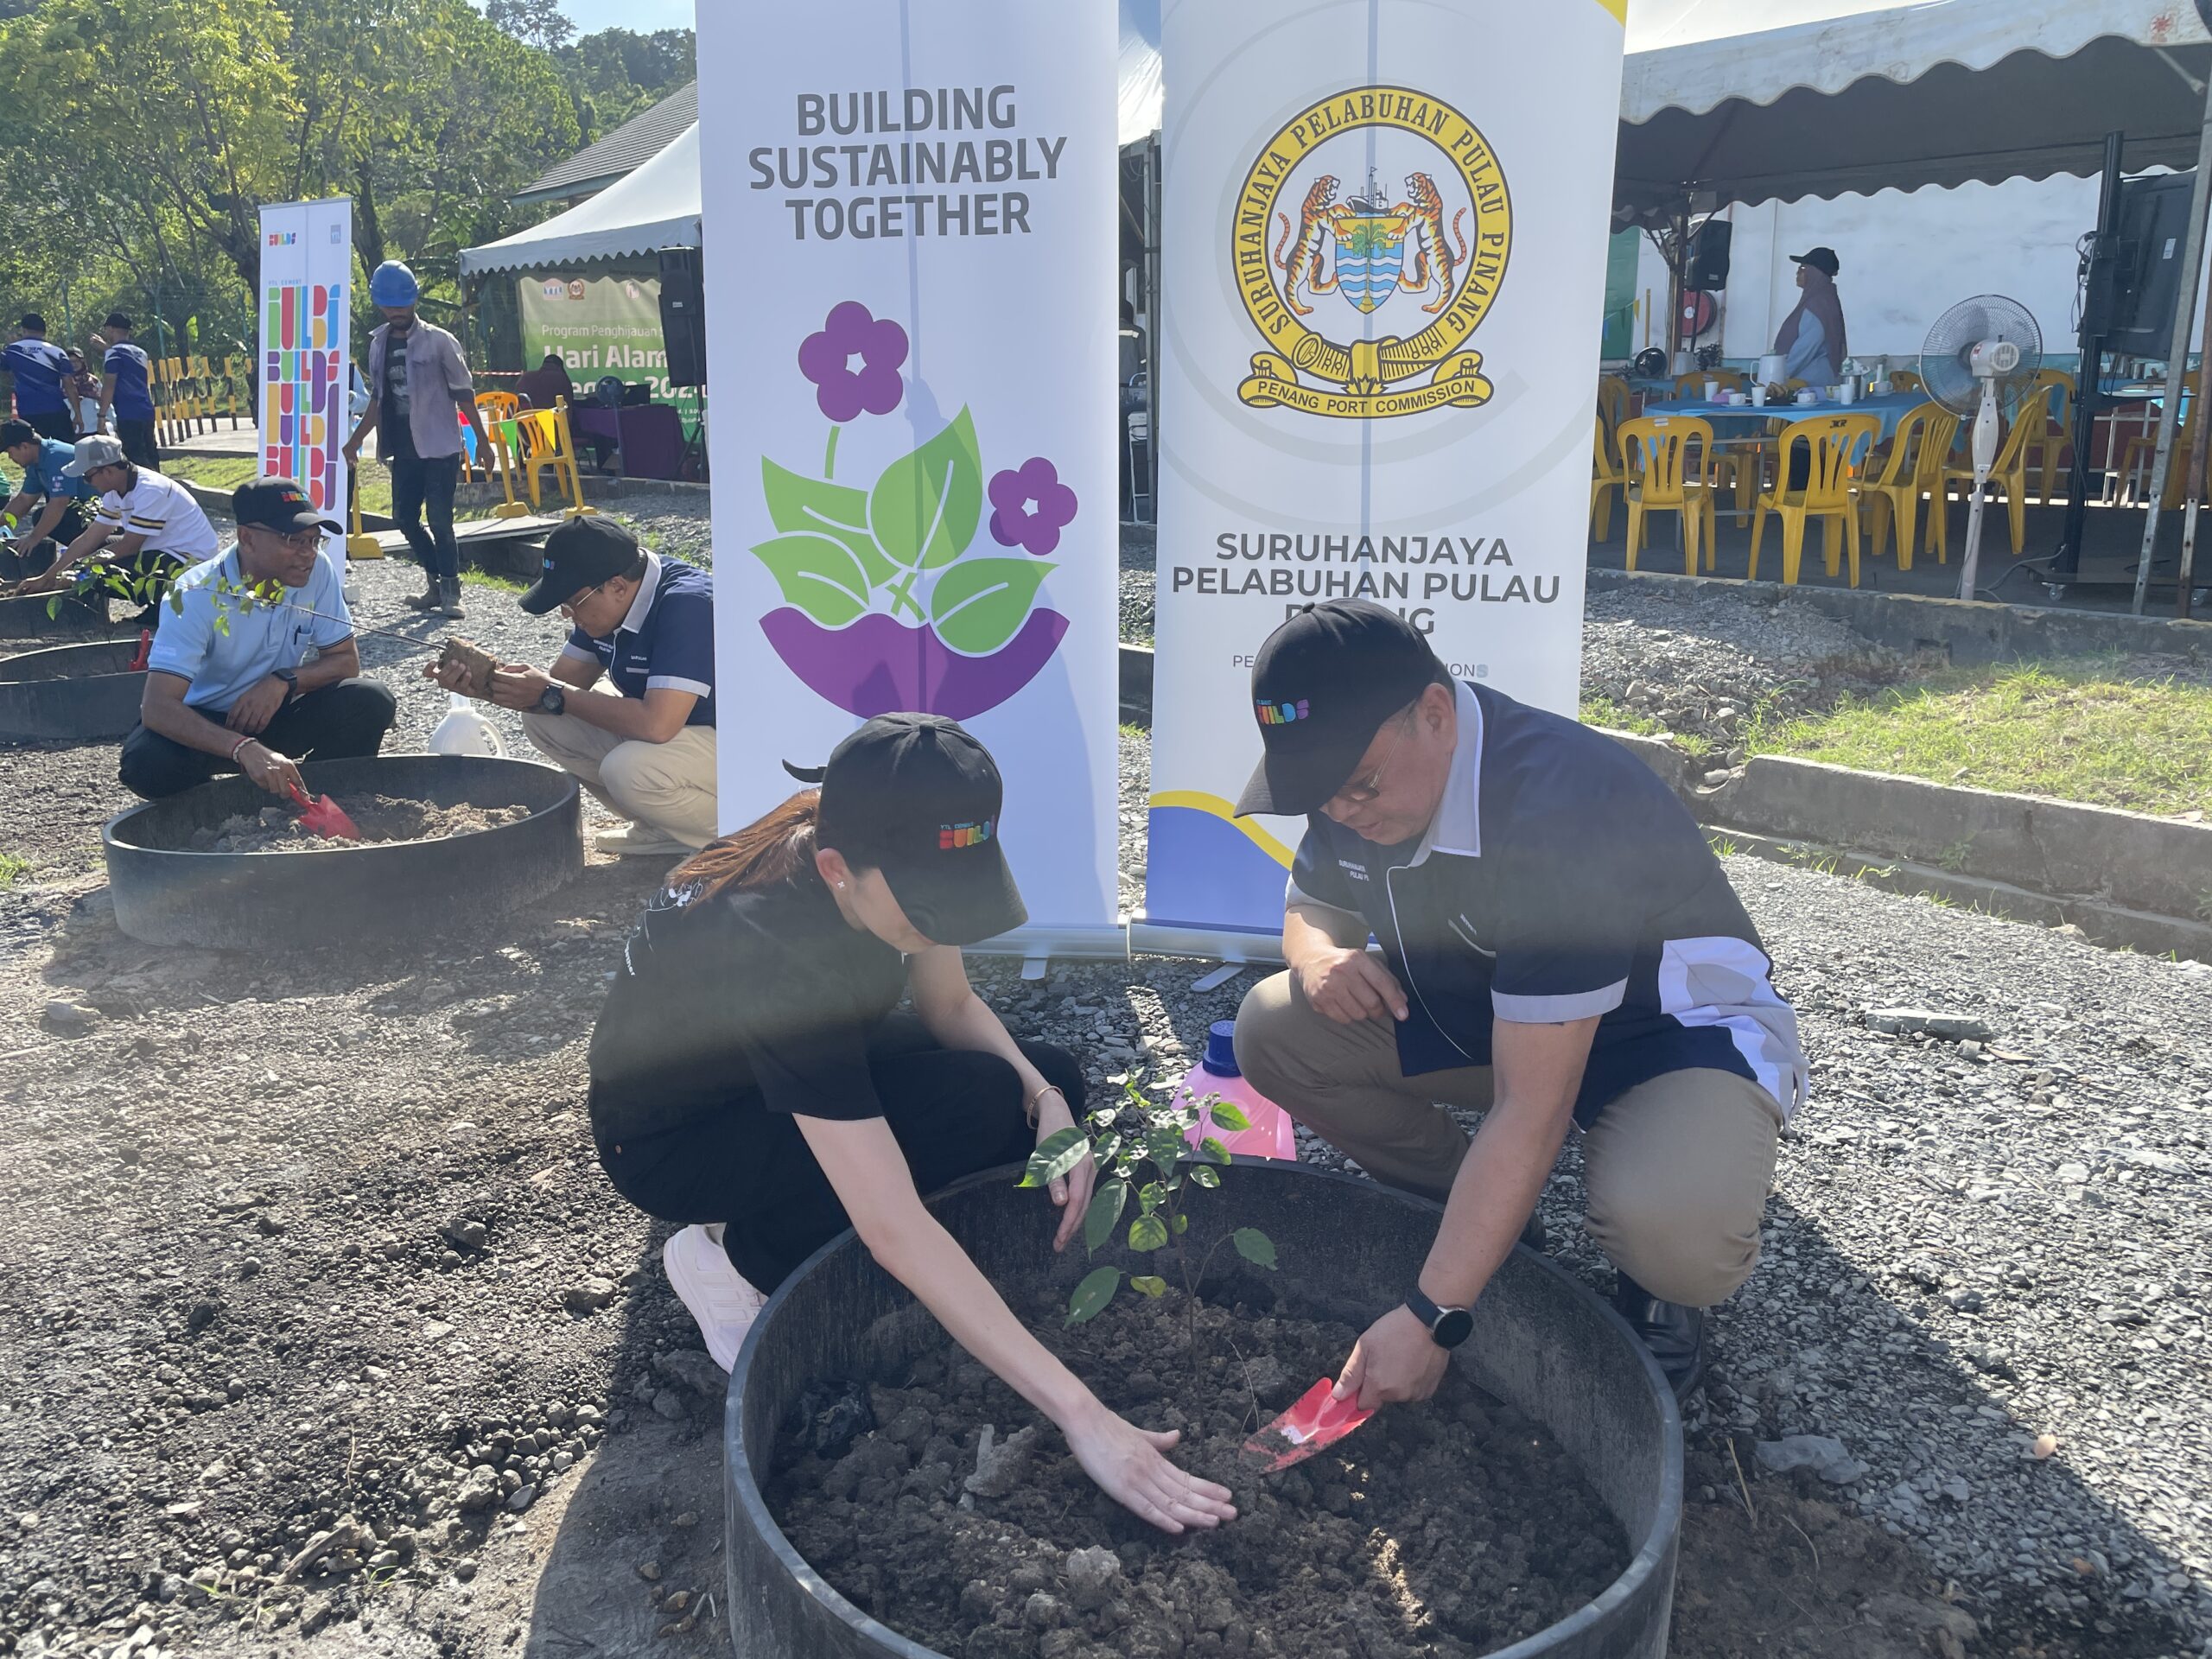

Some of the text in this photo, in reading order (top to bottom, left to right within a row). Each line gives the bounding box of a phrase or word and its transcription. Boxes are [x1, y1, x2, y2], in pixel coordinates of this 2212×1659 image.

[797, 85, 1015, 136] BUILDING
[748, 136, 1067, 190] SUSTAINABLY
[785, 191, 1031, 240] TOGETHER
[1240, 93, 1505, 335] SURUHANJAYA PELABUHAN PULAU PINANG
[542, 325, 589, 339] Program
[591, 325, 657, 339] Penghijauan
[1257, 379, 1475, 415] PENANG PORT COMMISSION
[1216, 531, 1513, 567] SURUHANJAYA
[1173, 566, 1560, 604] PELABUHAN PULAU
